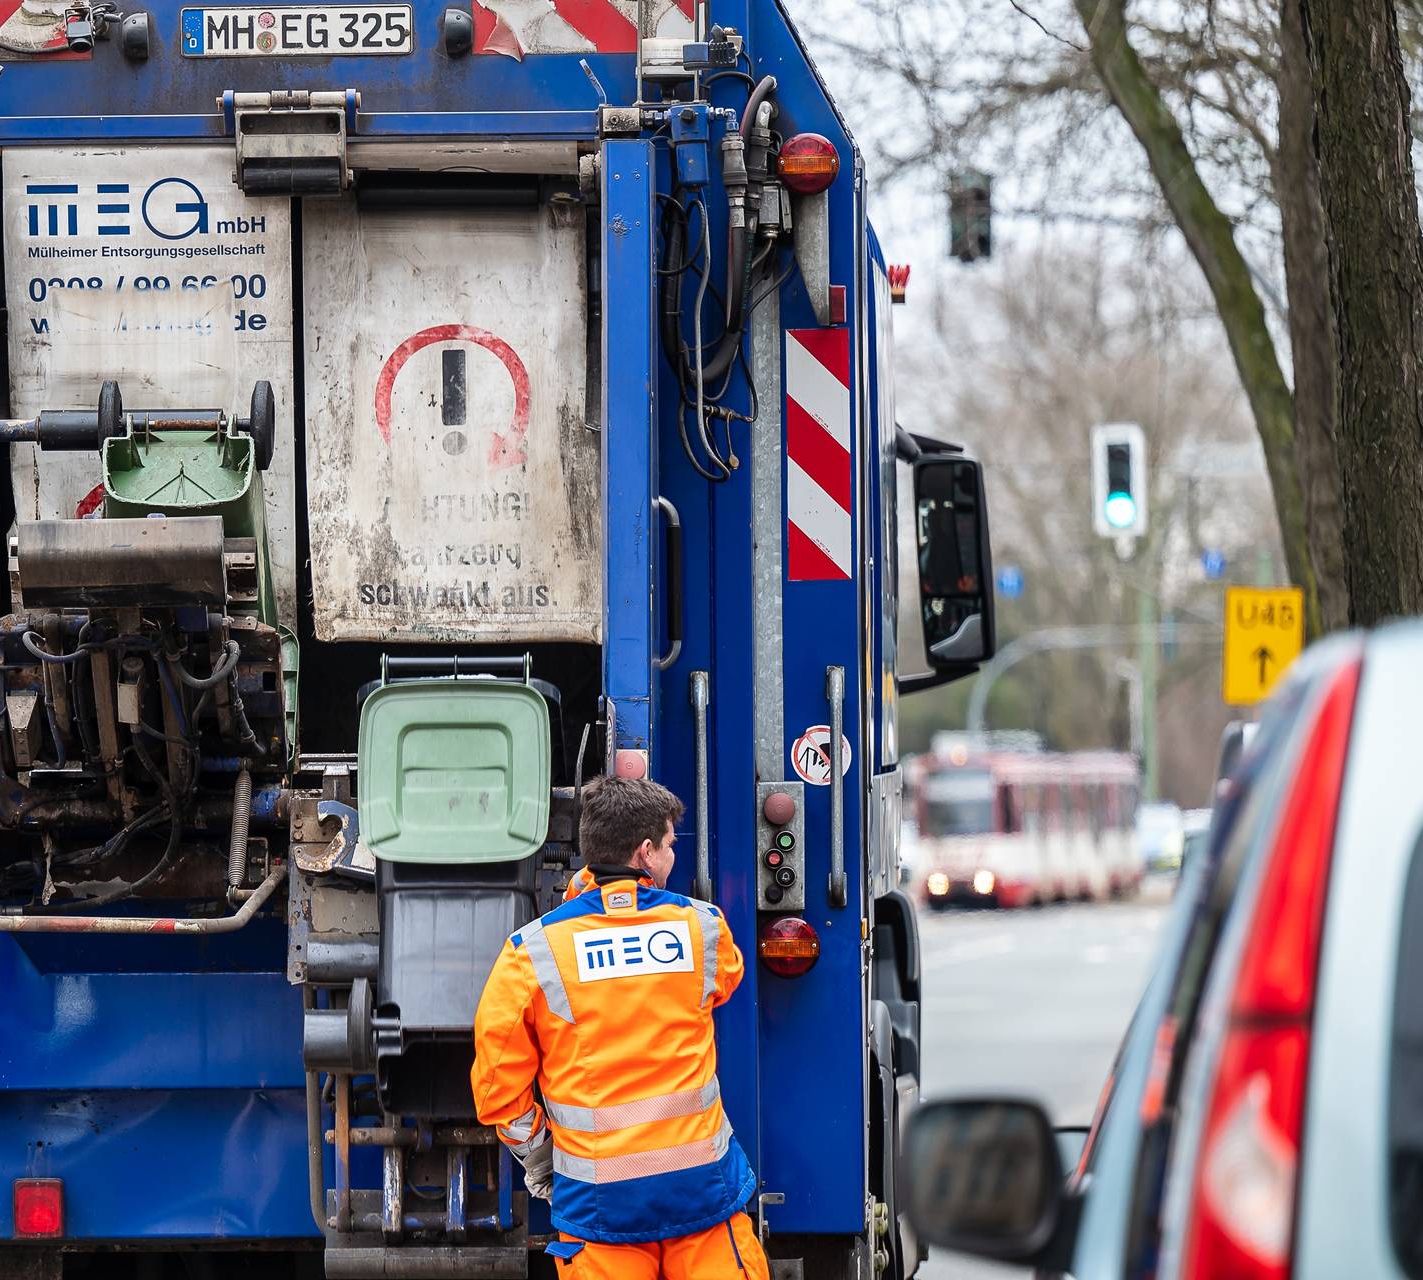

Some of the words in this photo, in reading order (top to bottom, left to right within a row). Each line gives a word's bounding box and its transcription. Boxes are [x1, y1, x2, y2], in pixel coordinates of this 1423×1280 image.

[207, 15, 255, 50] MH
[281, 14, 328, 49] EG
[338, 13, 406, 48] 325
[26, 177, 209, 240] MEG
[217, 216, 266, 234] mbH
[28, 246, 98, 258] Mülheimer
[102, 244, 266, 259] Entsorgungsgesellschaft
[501, 583, 558, 608] aus.
[584, 930, 684, 970] MEG
